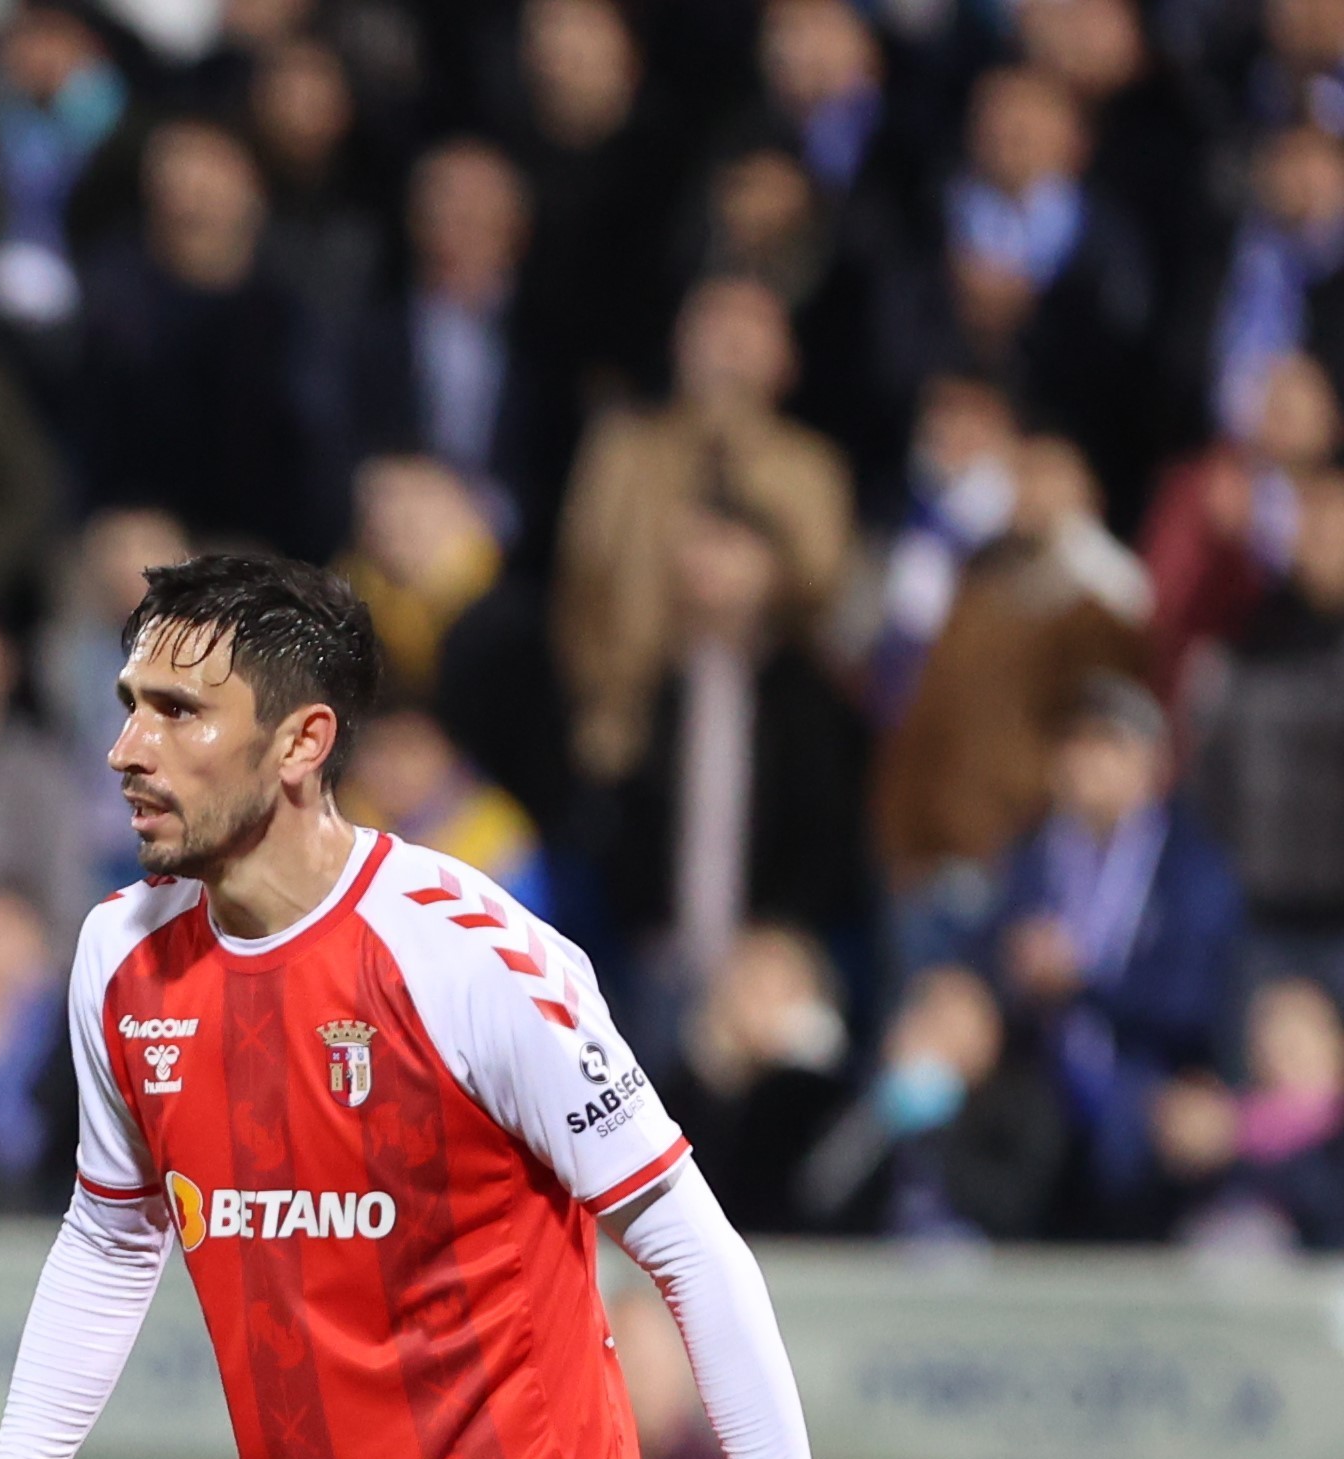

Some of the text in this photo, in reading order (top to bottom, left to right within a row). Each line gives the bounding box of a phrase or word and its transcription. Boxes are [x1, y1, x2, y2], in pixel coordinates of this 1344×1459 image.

[118, 1014, 199, 1039] 4MOOVE
[566, 1066, 646, 1134] SABSEG
[209, 1189, 396, 1239] BETANO
